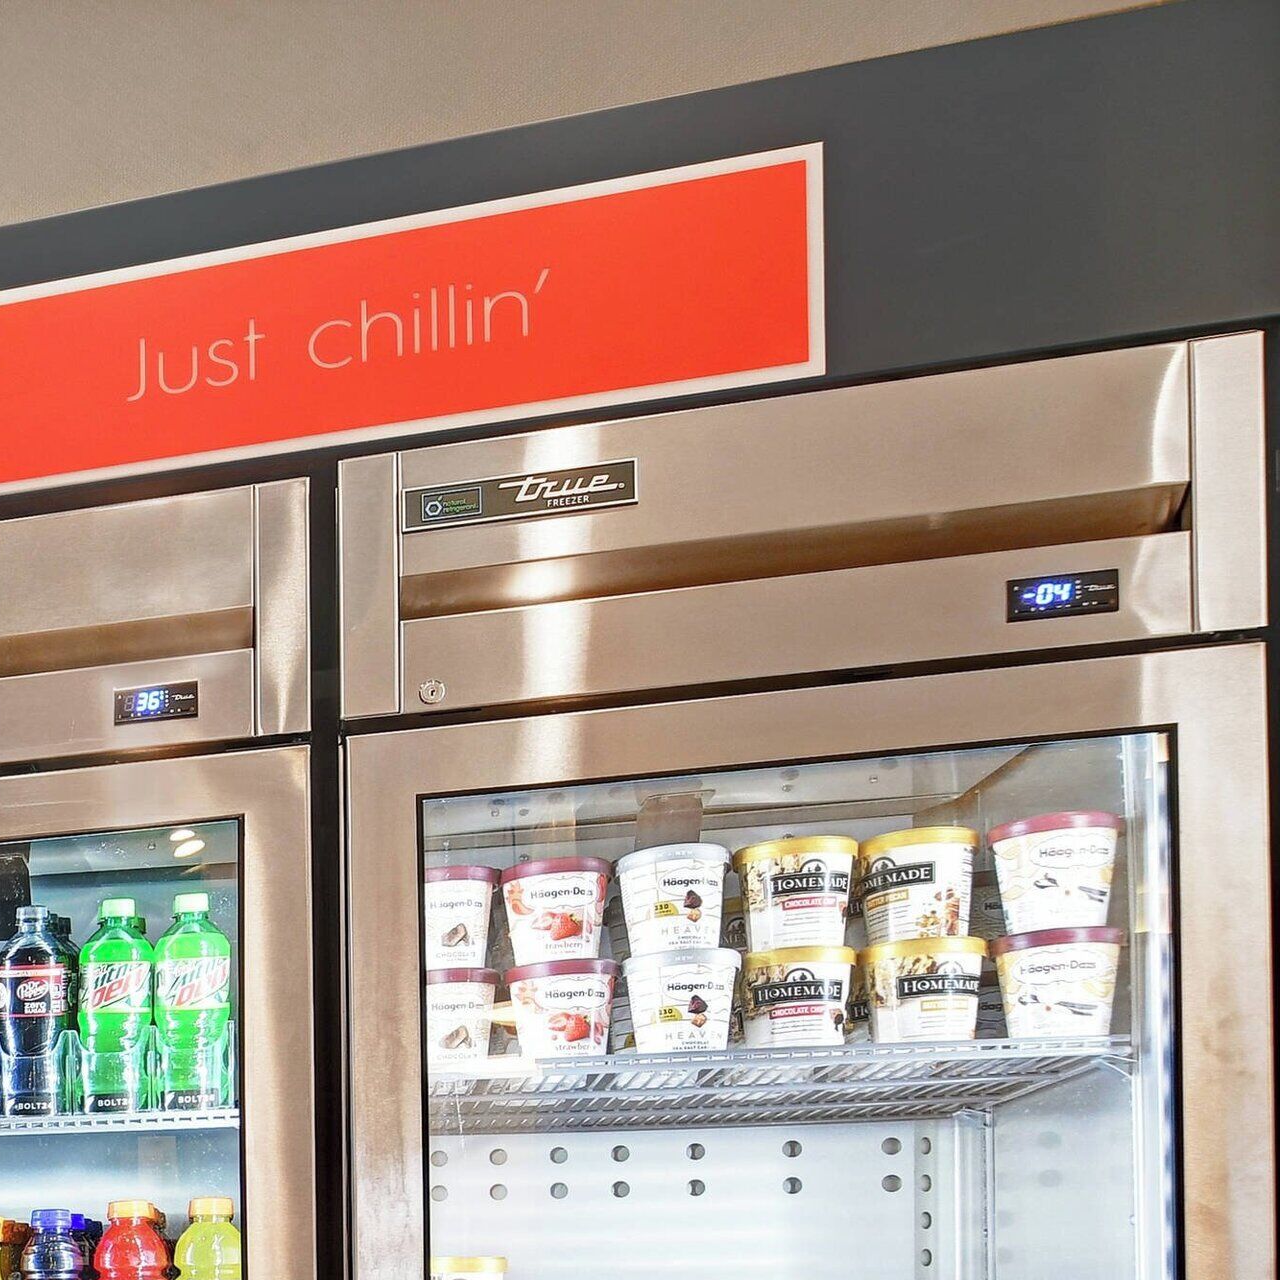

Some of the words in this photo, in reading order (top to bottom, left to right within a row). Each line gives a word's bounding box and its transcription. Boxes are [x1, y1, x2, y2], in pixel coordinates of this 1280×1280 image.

[127, 318, 266, 402] Just
[307, 268, 551, 370] chillin'
[547, 495, 590, 507] FREEZER
[756, 984, 842, 1003] HOMEMADE
[903, 978, 979, 994] HOMEMADE
